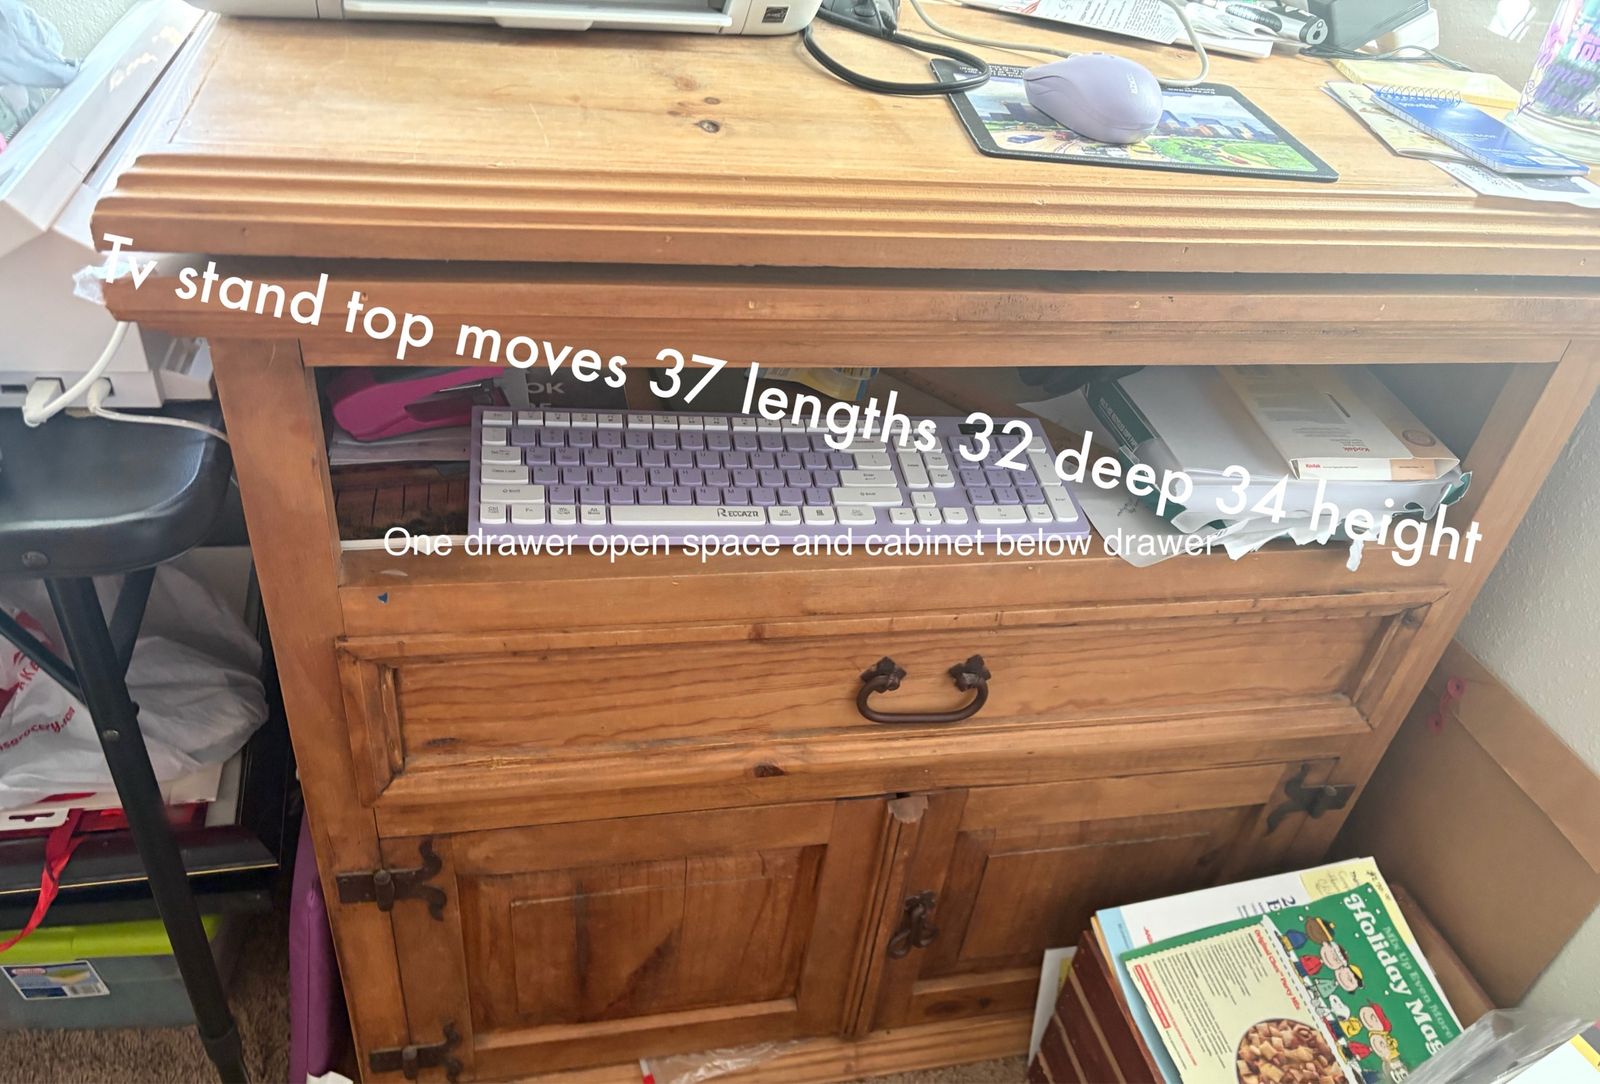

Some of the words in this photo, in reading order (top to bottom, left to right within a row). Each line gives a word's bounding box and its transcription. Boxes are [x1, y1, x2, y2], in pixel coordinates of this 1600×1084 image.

[1343, 893, 1412, 996] Holiday
[1383, 926, 1399, 951] Mix
[1398, 951, 1413, 970] Up
[1409, 971, 1432, 1004] Even
[1429, 1004, 1454, 1039] More
